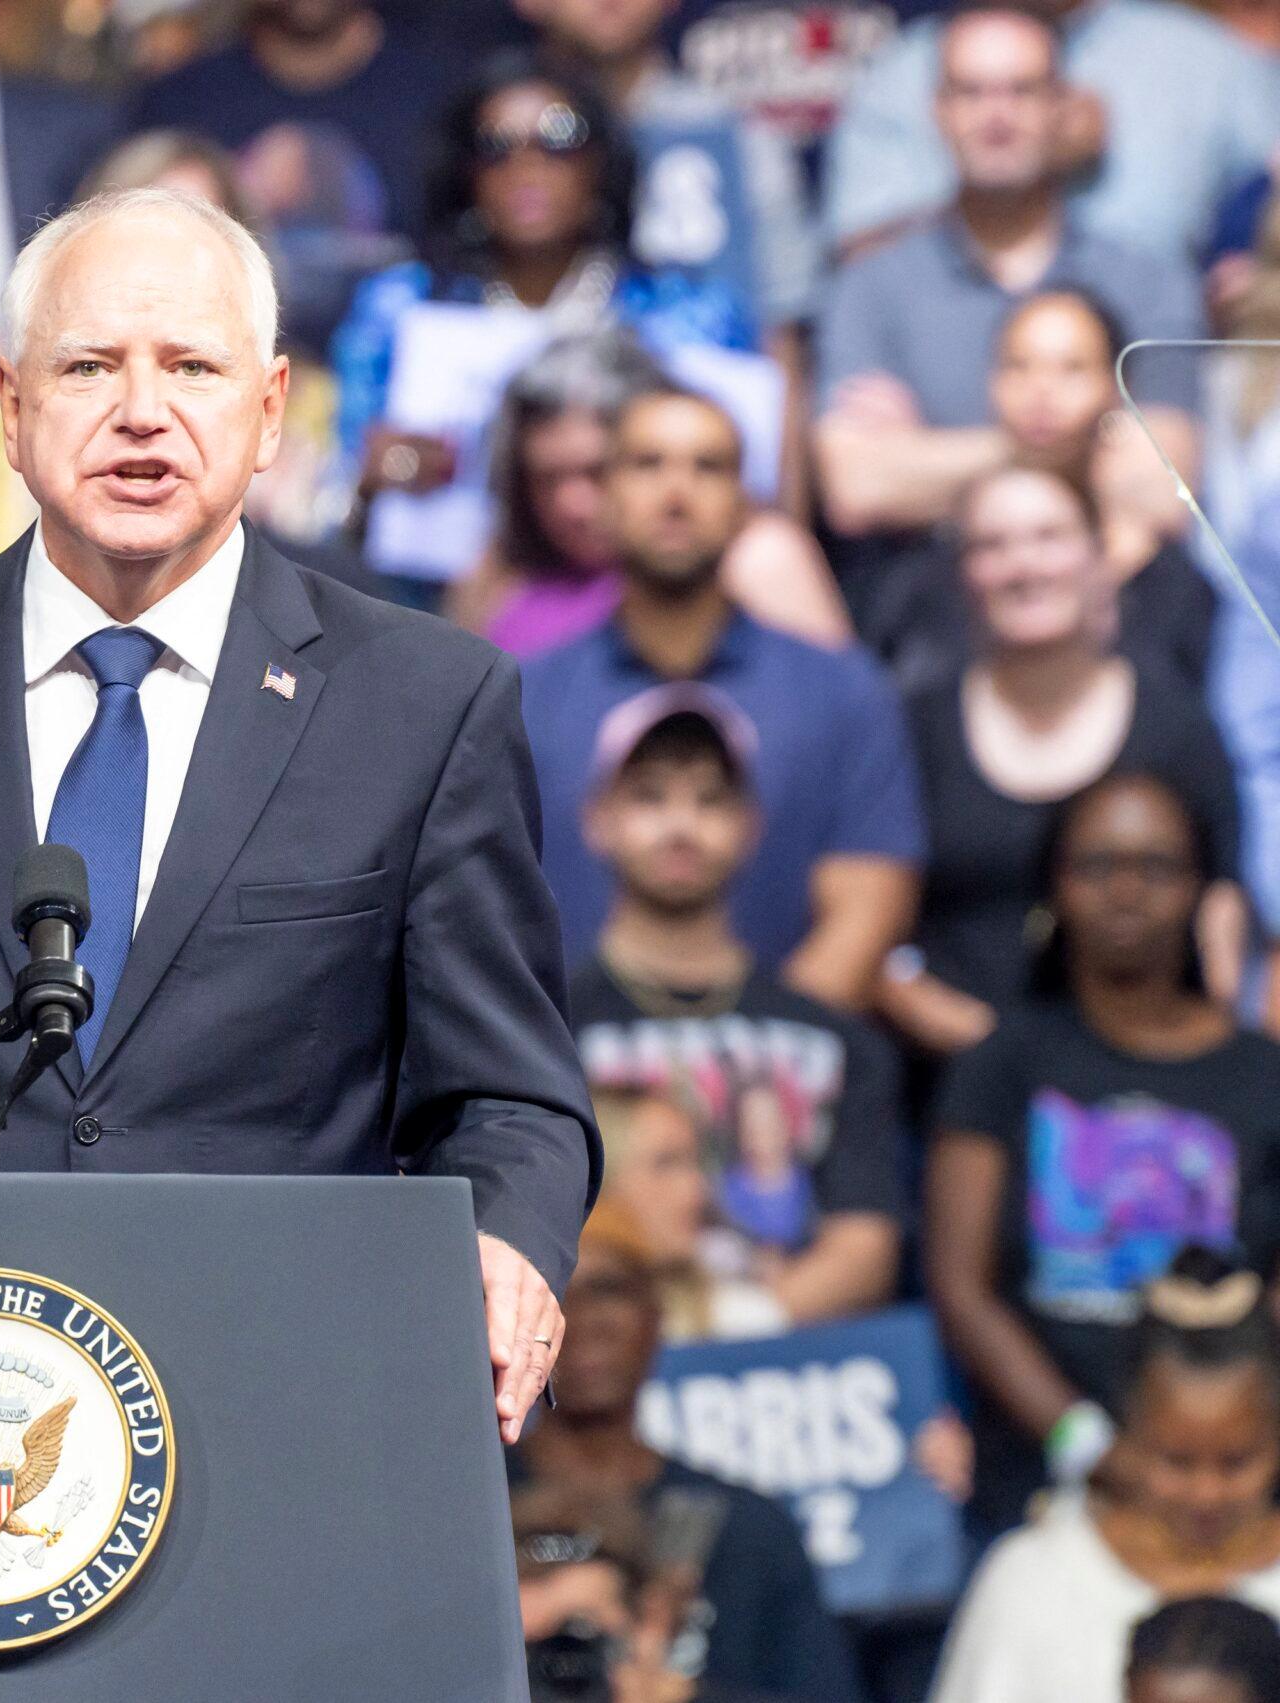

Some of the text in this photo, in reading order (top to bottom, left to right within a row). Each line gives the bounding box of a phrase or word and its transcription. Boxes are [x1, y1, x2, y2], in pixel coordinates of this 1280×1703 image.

[0, 1407, 30, 1419] UNUM
[62, 1302, 164, 1457] UNITED
[48, 1482, 161, 1622] STATES
